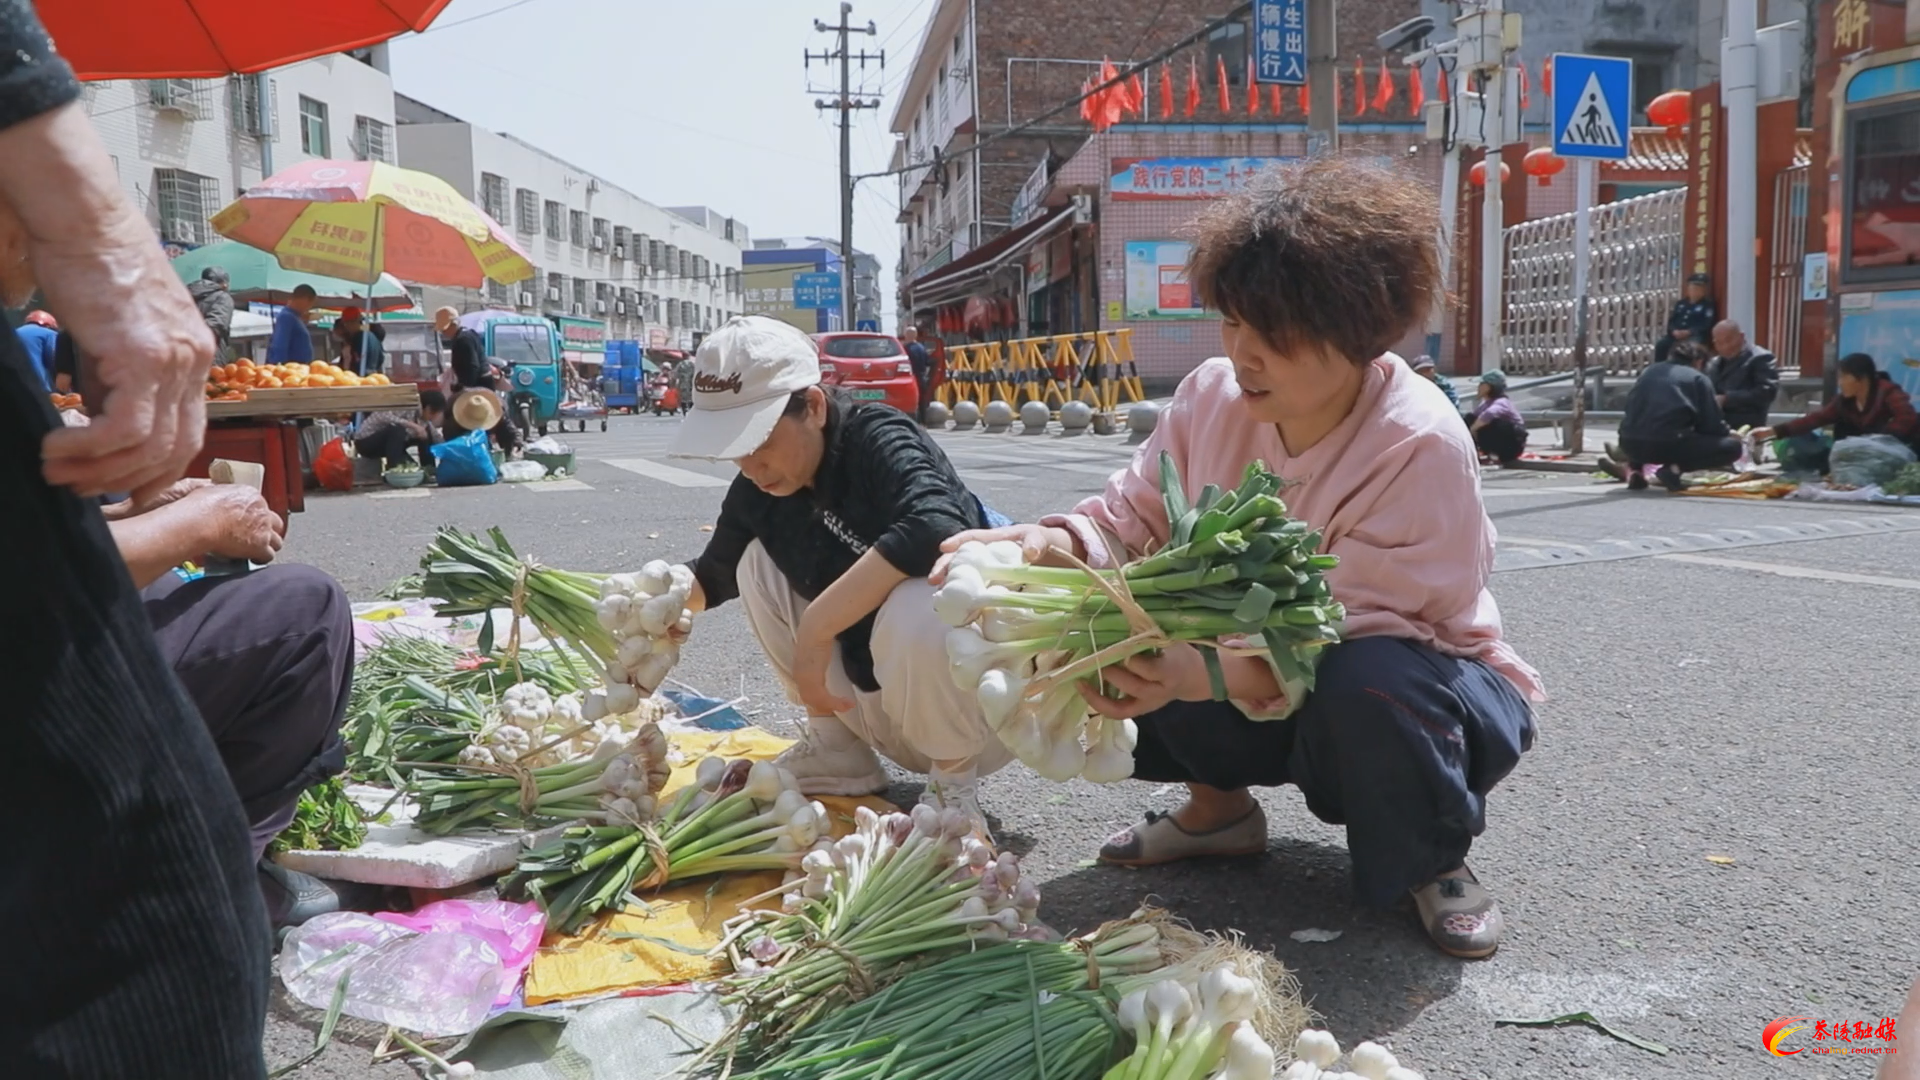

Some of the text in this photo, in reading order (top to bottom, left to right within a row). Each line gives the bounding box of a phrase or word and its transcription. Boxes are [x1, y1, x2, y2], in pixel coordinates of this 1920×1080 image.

[1261, 0, 1281, 77] 辆慢行
[1284, 0, 1303, 79] 生出入
